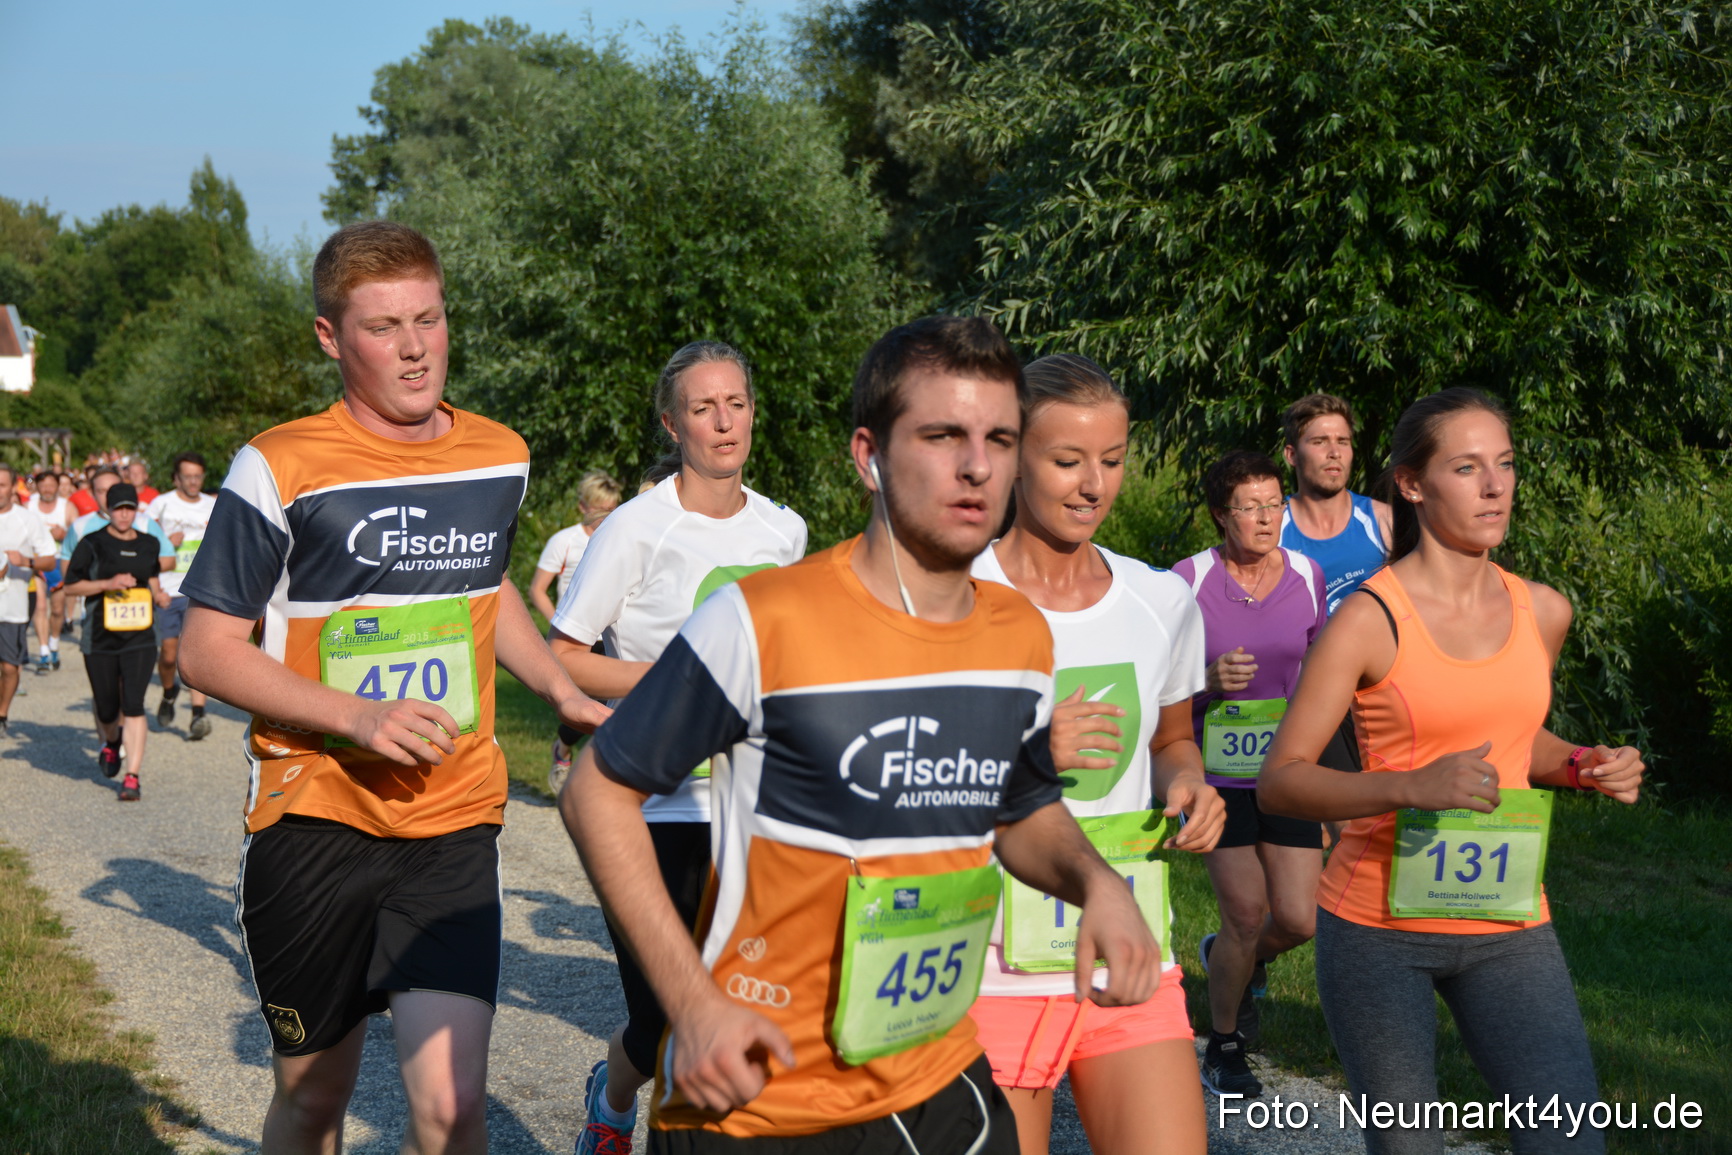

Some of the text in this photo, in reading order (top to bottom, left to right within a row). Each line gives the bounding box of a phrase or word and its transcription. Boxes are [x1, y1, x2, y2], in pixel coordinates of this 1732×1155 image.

[381, 528, 497, 557] Fischer
[392, 556, 491, 571] AUTOMOBILE
[1345, 568, 1365, 580] Bau
[112, 605, 145, 618] 1211
[345, 629, 401, 643] firmenlauf
[355, 658, 448, 701] 470
[266, 731, 287, 740] Audi
[1222, 731, 1275, 756] 302
[880, 748, 1011, 788] Fischer
[894, 790, 1000, 809] AUTOMOBILE
[1426, 840, 1509, 883] 131
[1427, 891, 1501, 900] Bettina Hollweck
[876, 939, 968, 1007] 455
